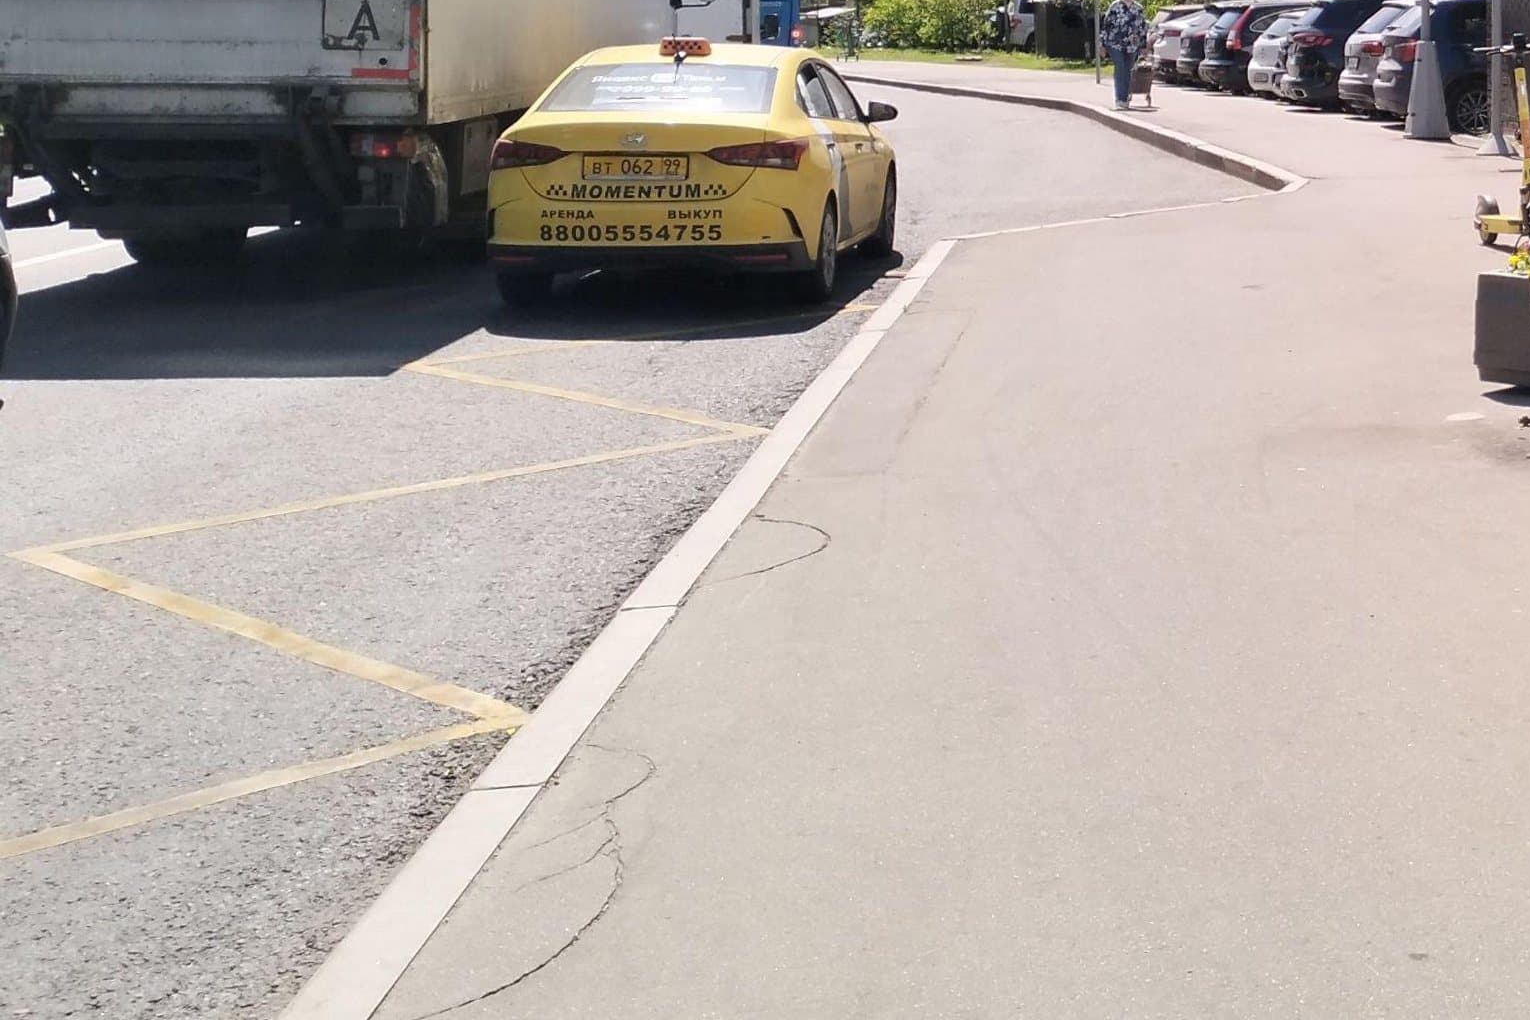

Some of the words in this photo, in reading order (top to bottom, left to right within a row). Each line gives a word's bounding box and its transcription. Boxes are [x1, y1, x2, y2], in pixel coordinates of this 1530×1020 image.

[621, 159, 653, 174] 062
[664, 159, 680, 173] 99
[571, 184, 701, 199] MOMENTUM
[541, 209, 594, 220] АРЕНДА
[667, 209, 723, 220] ВЫКУП
[540, 224, 722, 242] 88005554755
